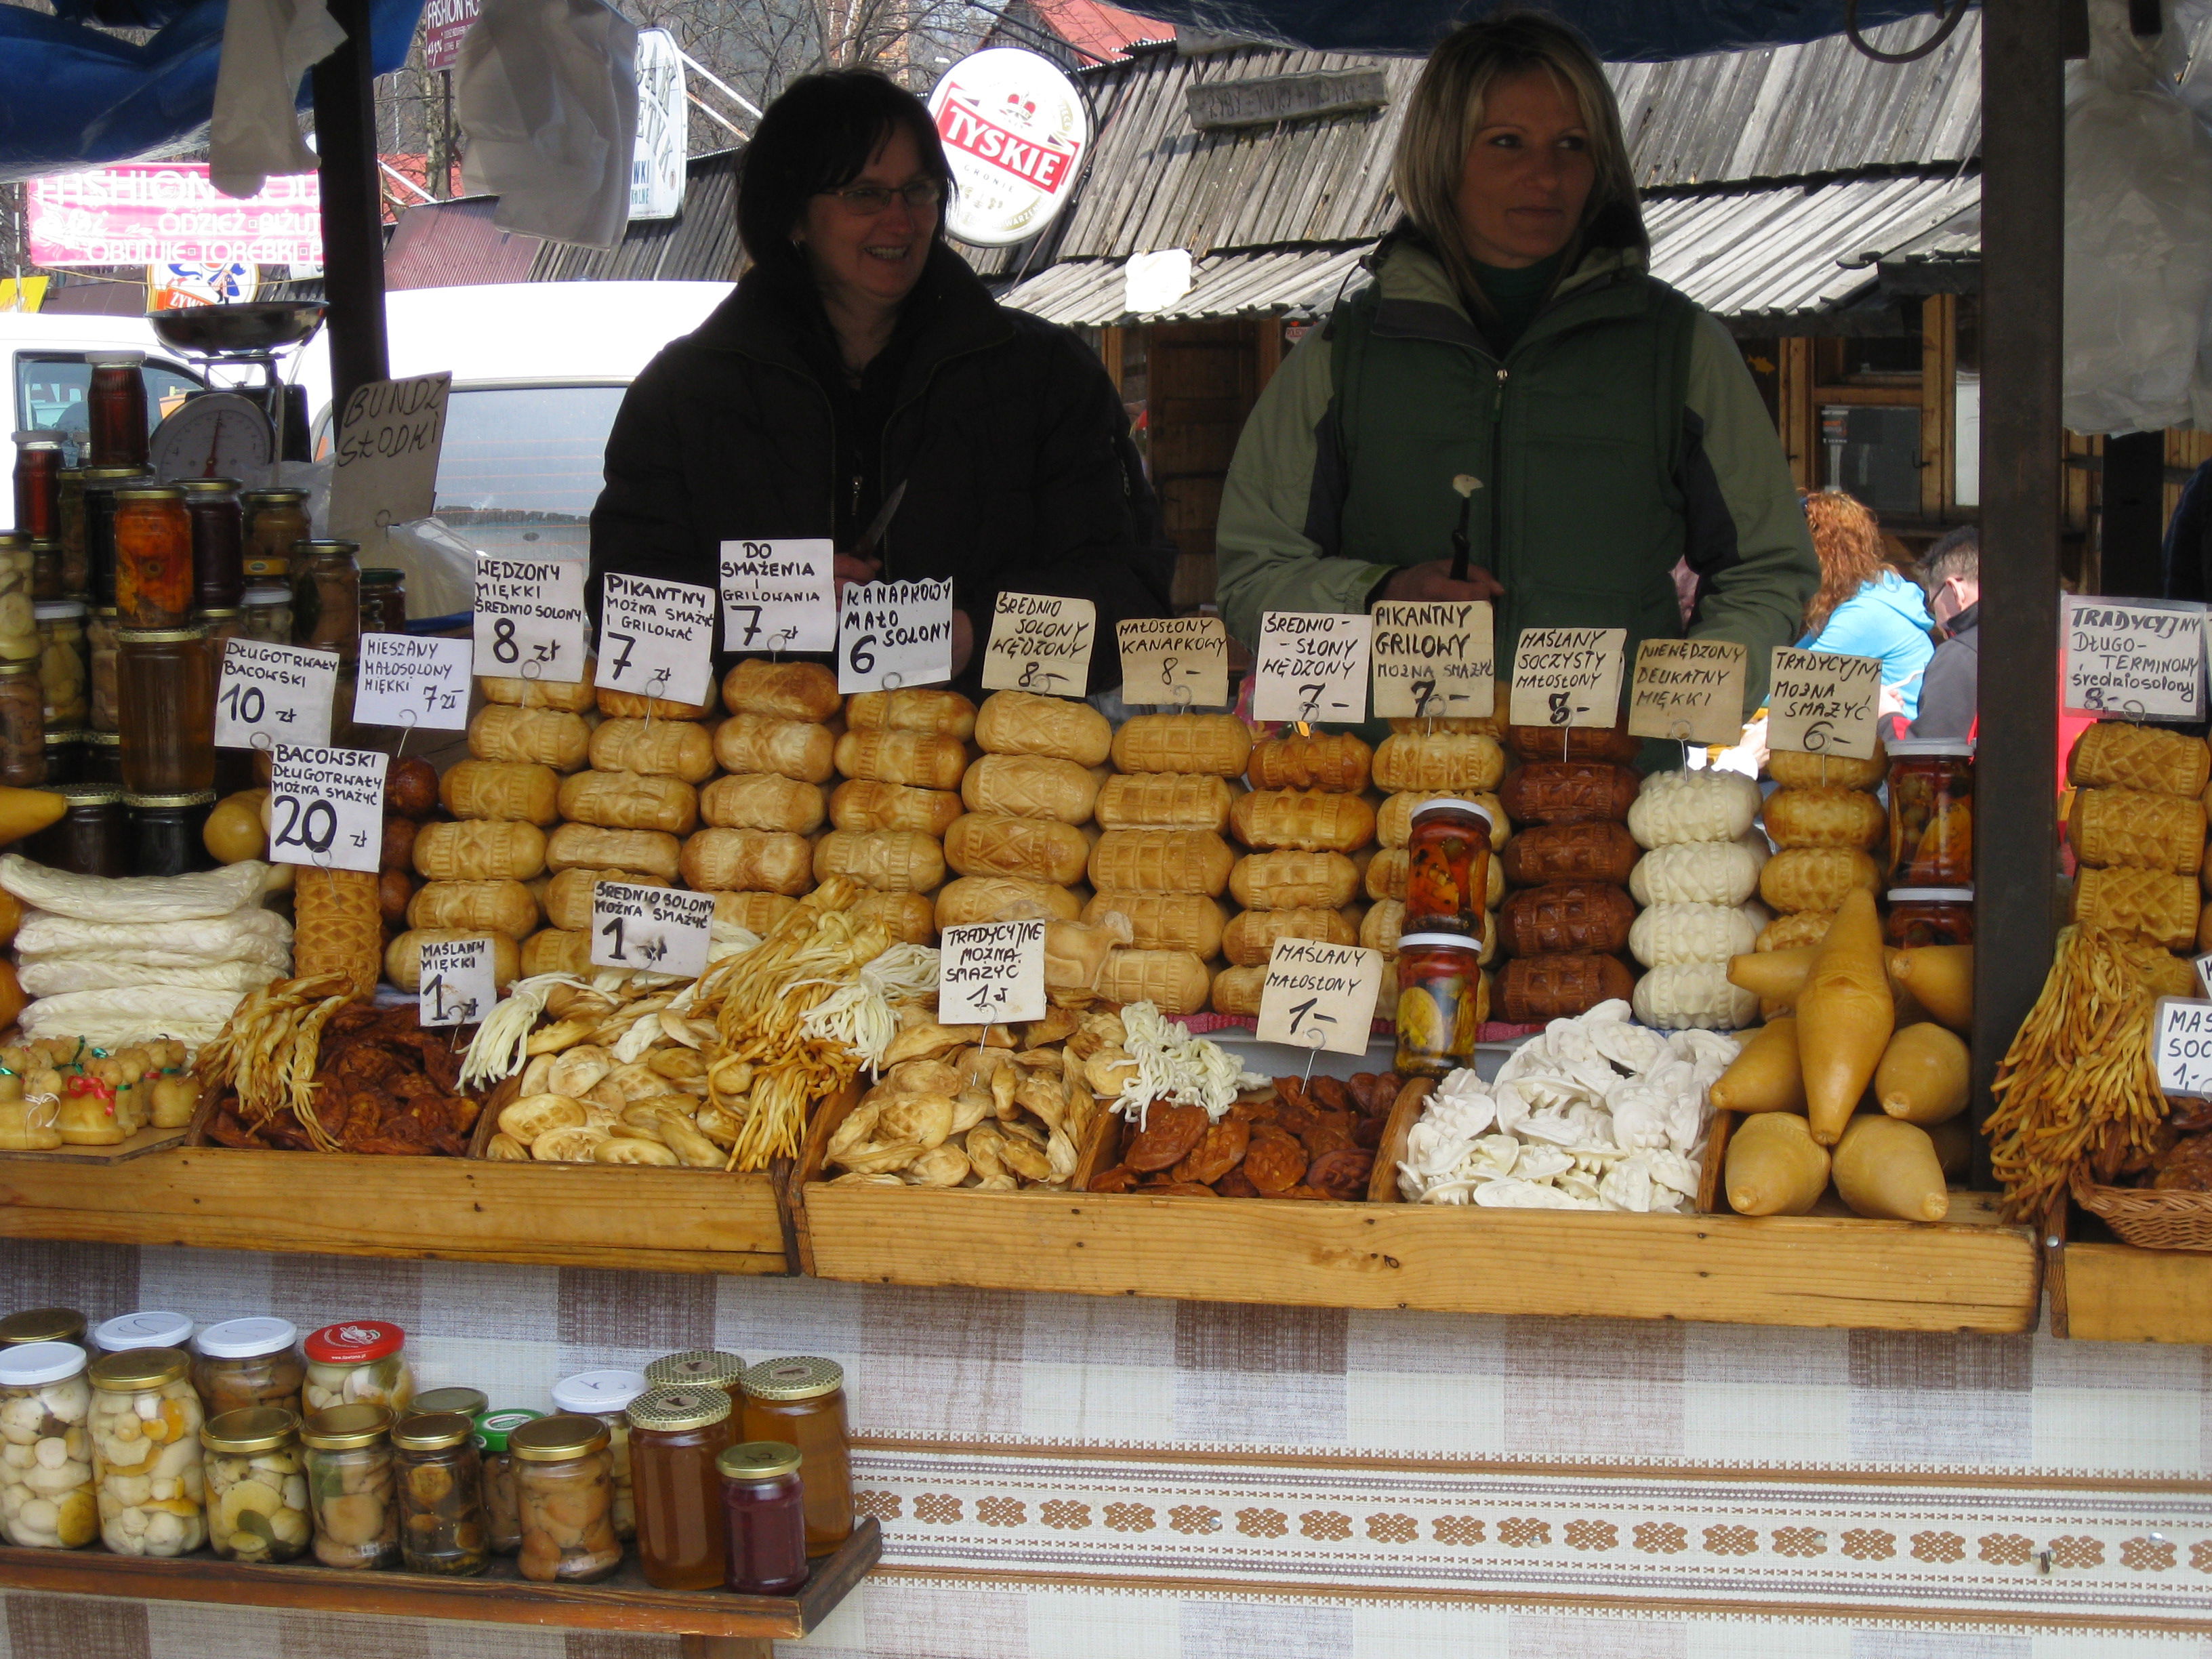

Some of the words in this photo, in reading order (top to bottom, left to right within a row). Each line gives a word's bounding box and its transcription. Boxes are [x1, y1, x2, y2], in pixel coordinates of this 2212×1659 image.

[428, 0, 464, 29] FASHION
[466, 0, 480, 19] HO
[947, 106, 1061, 186] TYSKIE
[37, 170, 216, 205] FASHION
[964, 165, 1015, 193] GRONIE
[258, 209, 321, 236] BIŻUT
[87, 241, 187, 262] OBUWIE
[199, 240, 299, 262] TOREBKI
[742, 542, 772, 559] DO
[477, 559, 560, 582] WĘDZONY
[721, 560, 815, 577] SMAŻENIA
[475, 582, 541, 600] MIĘKKI
[605, 574, 705, 608] PIKANTNY
[723, 590, 820, 602] GRILOWANIA
[847, 581, 951, 606] KANAPKOWY
[995, 591, 1062, 617] ŚREDNIO
[474, 596, 532, 615] ŚREDNIO
[535, 605, 581, 622] SOLONY
[605, 595, 657, 616] MOŻNA
[665, 608, 715, 628] SMAŻYĆ
[844, 610, 899, 631] MAŁO
[1376, 603, 1473, 629] PIKANTNY
[621, 615, 693, 641] GRILOWAĆ
[730, 605, 763, 647] 7
[781, 626, 798, 639] zł
[882, 620, 950, 647] SOLONY
[1015, 618, 1089, 643] SOLONY
[1120, 619, 1213, 637] MAŁOSŁONY
[2071, 607, 2201, 639] TRADYCYJNY
[493, 617, 519, 663] 8
[533, 639, 561, 661] zł
[992, 636, 1088, 659] WĘDZONY
[1122, 637, 1227, 657] KANAPKOWY
[1375, 632, 1471, 661] GRILOWY
[1520, 629, 1607, 650] MAŚLANY
[1640, 642, 1746, 663] NIEWĘDZONY
[226, 642, 337, 672] DŁUGOTRWAŁY
[607, 631, 636, 680] 7
[654, 667, 672, 682] zł
[850, 634, 877, 674] 6
[1518, 650, 1606, 671] SOCZYSTY
[2100, 655, 2198, 677] TERMINOWY
[224, 660, 306, 688] BACOWSKI
[1262, 657, 1355, 680] WĘDZONY
[1637, 666, 1730, 686] DELIKATNY
[1776, 652, 1882, 683] TRADYCYJNY
[1515, 672, 1602, 690] MAŁOSŁONY
[220, 683, 265, 723] 10
[275, 708, 297, 722] zł
[423, 684, 438, 712] 7
[1637, 690, 1712, 710] MIĘKKI
[275, 743, 376, 768] BACOWSKI
[272, 764, 383, 790] DŁUGOTRWAŁY
[272, 780, 320, 796] MOŻNA
[325, 788, 377, 806] SMAŻYĆ
[274, 795, 337, 853] 20
[350, 830, 367, 848] zł
[594, 900, 642, 917] MOŻNA
[653, 908, 708, 929] SMAŻYĆ
[663, 893, 715, 914] SOLONY
[422, 940, 485, 957] MAŚLANY
[602, 917, 626, 960] 1
[947, 922, 1044, 949] TRADYCYJNE
[421, 957, 476, 972] MIĘKKI
[1275, 941, 1367, 967] MAŚLANY
[966, 984, 989, 1008] 1
[1266, 972, 1361, 996] MAŁOSŁONY
[423, 974, 449, 1021] 1
[2168, 1038, 2212, 1058] SOC
